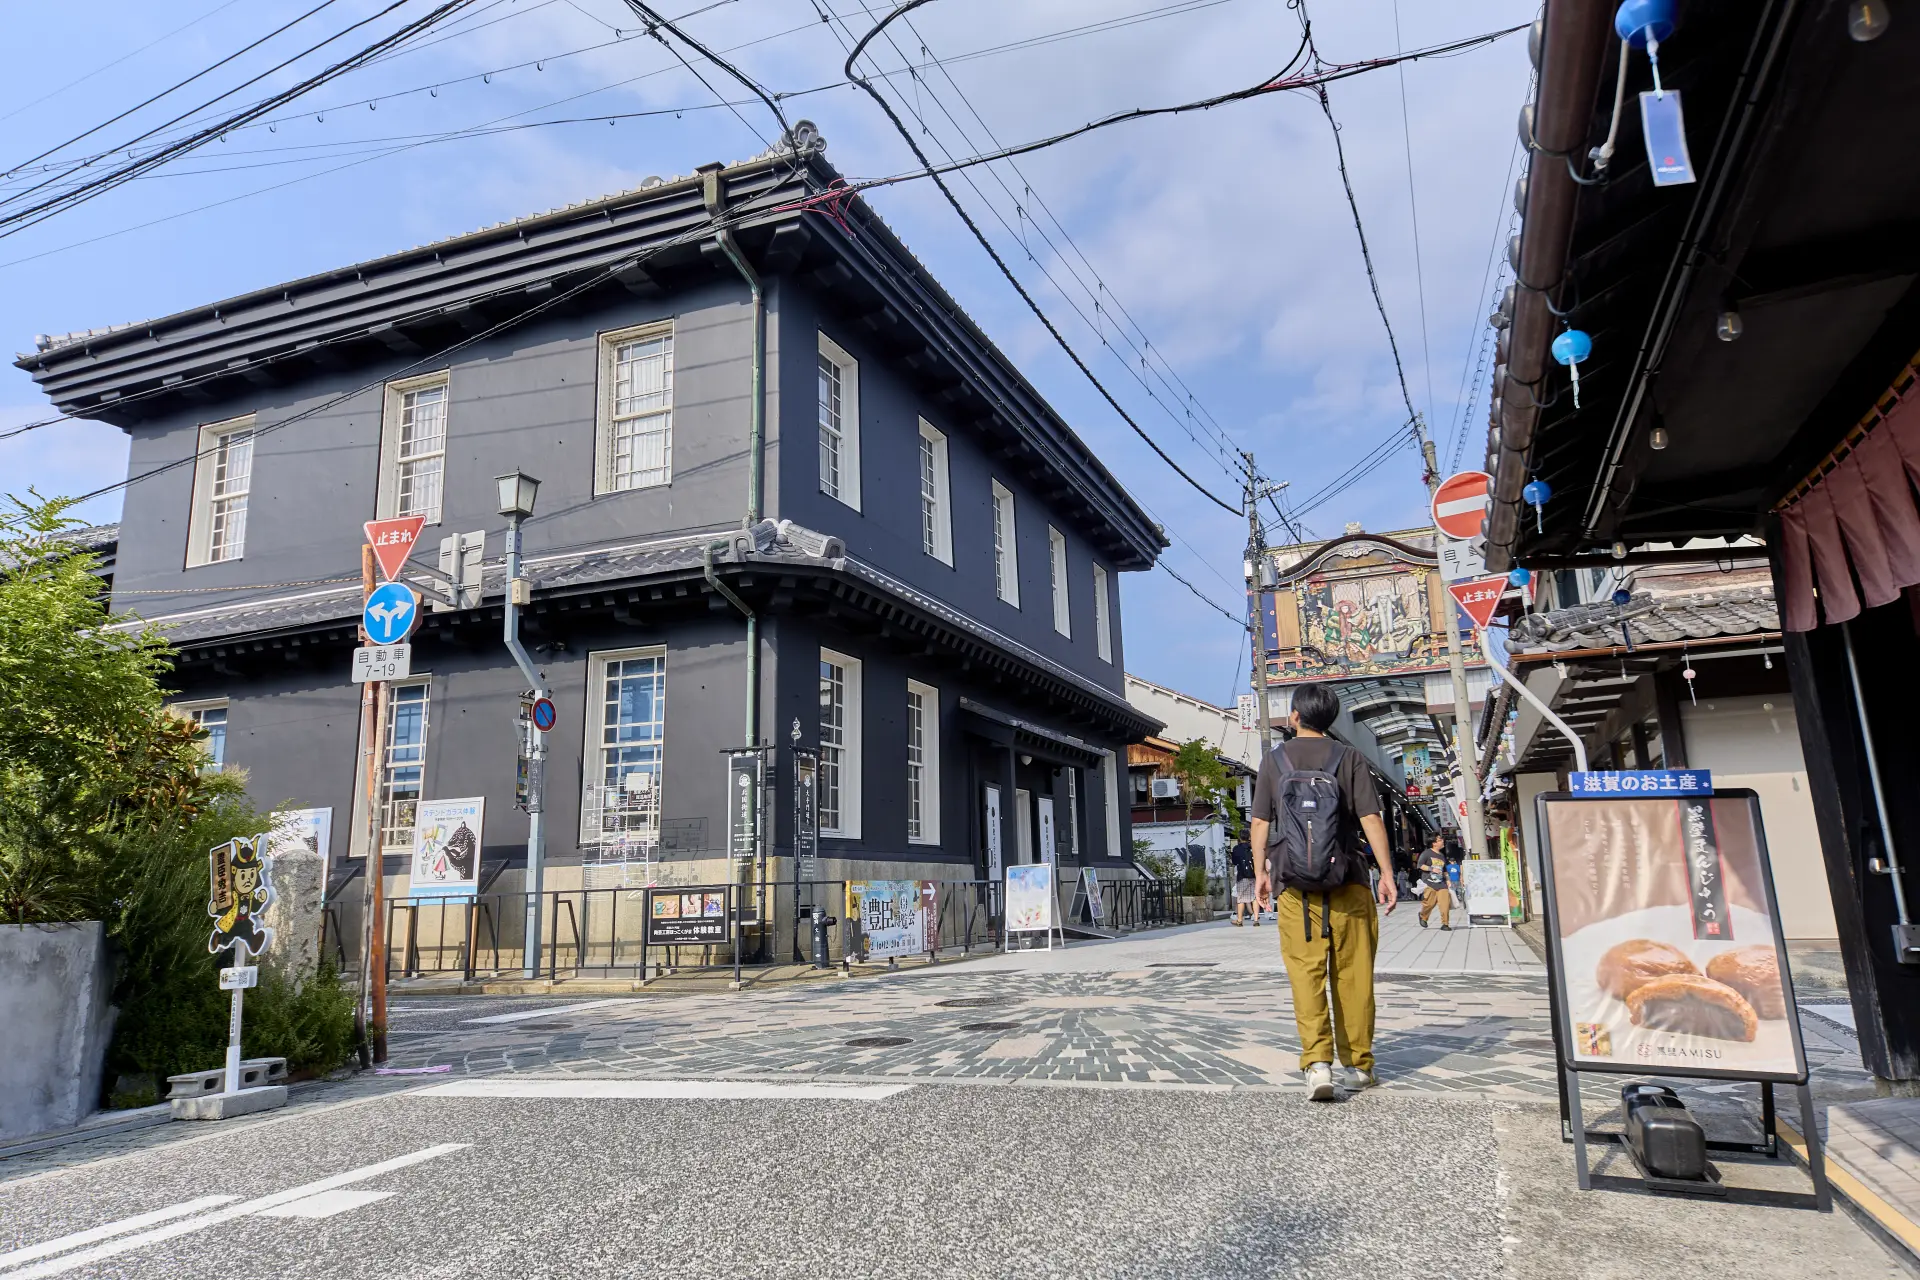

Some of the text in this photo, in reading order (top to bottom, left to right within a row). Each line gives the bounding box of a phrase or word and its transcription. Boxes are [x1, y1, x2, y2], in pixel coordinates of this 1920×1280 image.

[375, 529, 414, 546] 止まれ
[1462, 588, 1498, 604] 止まれ
[358, 648, 405, 664] 自動車
[365, 662, 396, 678] 7-19
[1584, 774, 1699, 792] 滋賀のお土産
[693, 926, 722, 934] 体験教室
